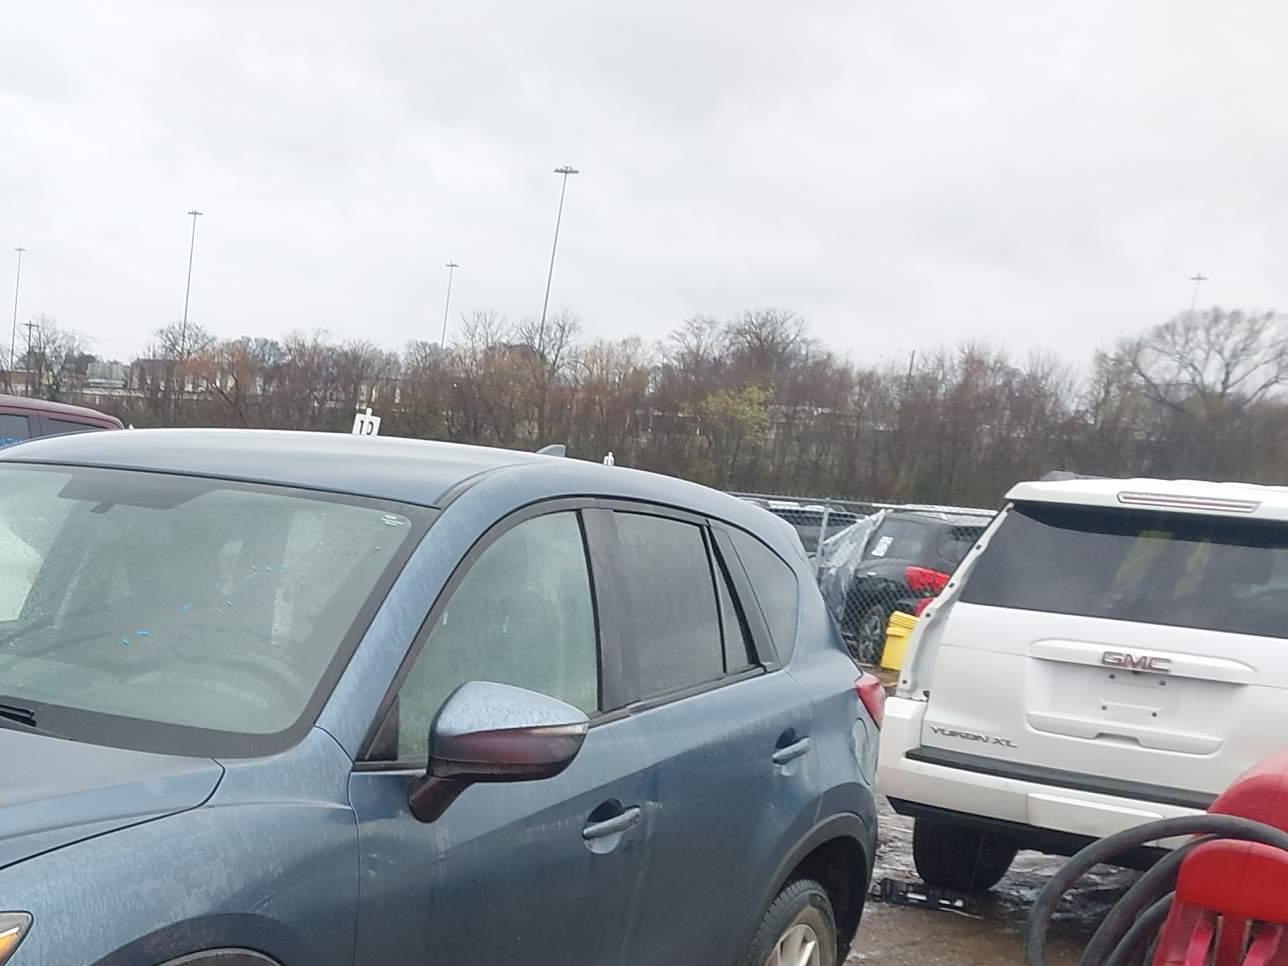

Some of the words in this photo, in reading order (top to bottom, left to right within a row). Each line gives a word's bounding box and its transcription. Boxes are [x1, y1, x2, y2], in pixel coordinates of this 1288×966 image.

[1102, 651, 1172, 673] GMC
[930, 726, 989, 743] YUKON
[992, 737, 1018, 748] XL
